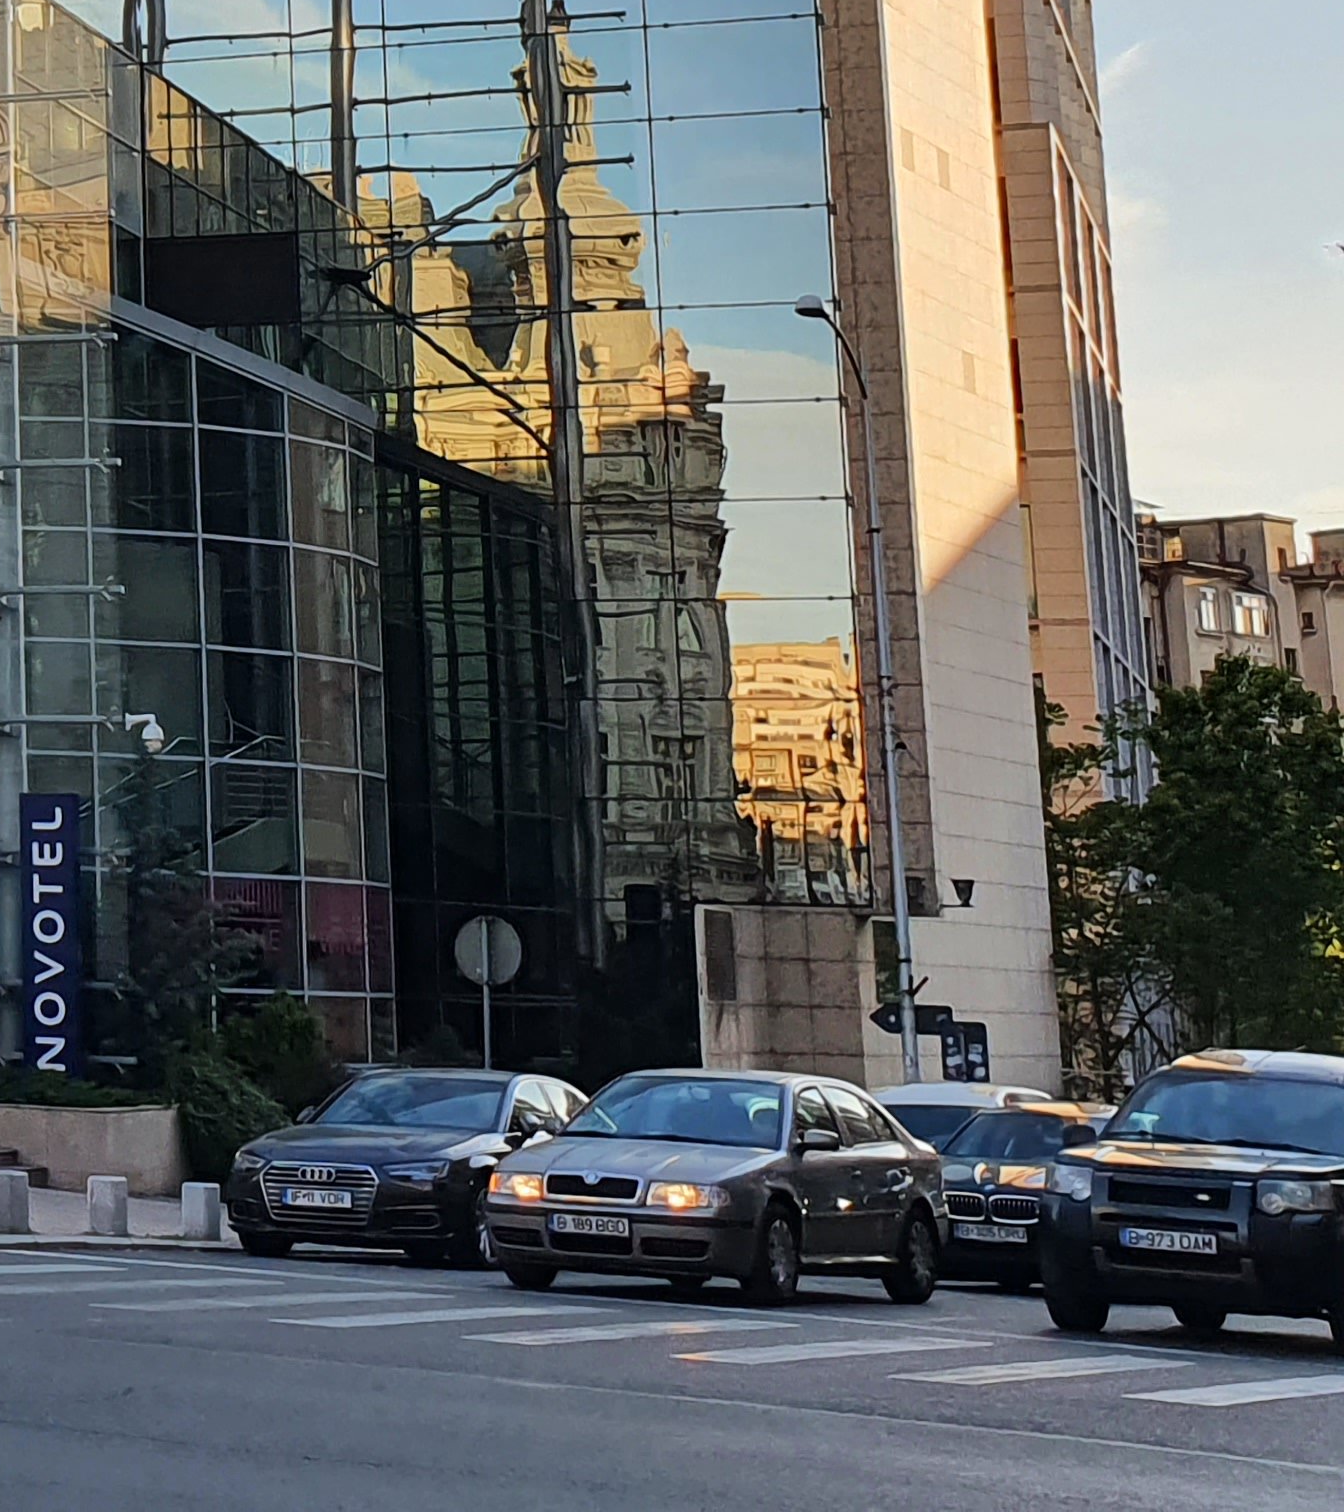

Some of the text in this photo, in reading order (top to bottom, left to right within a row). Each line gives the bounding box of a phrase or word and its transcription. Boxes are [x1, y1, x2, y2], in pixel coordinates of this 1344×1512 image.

[31, 806, 67, 1072] NOVOTEL
[557, 1215, 567, 1230] B
[1128, 1230, 1140, 1245] B
[1145, 1232, 1175, 1248] 973
